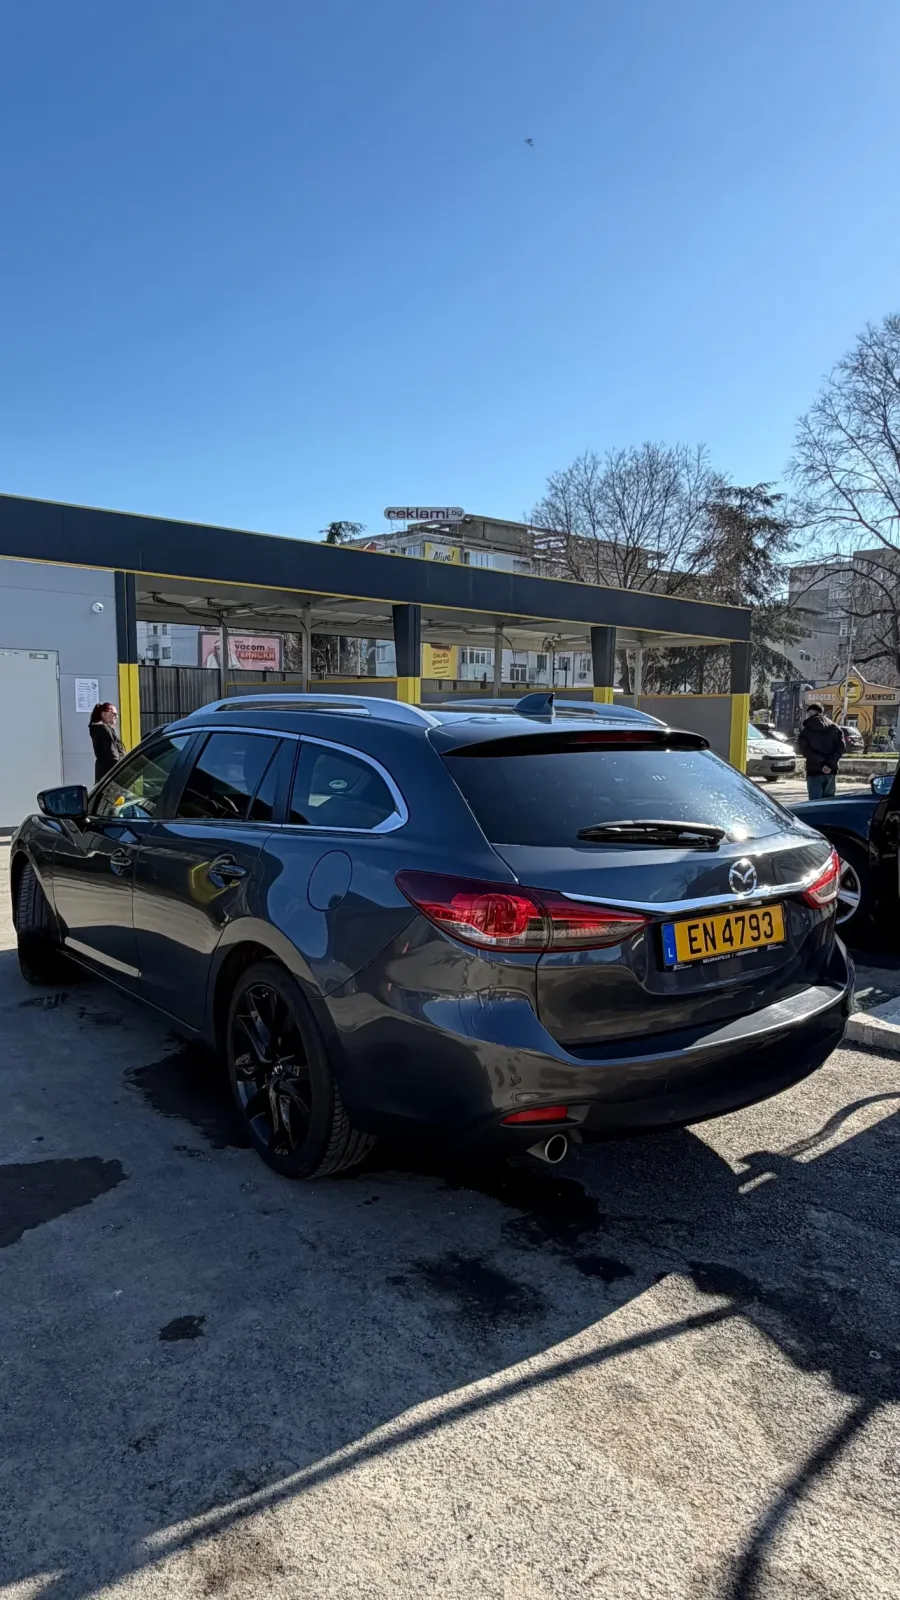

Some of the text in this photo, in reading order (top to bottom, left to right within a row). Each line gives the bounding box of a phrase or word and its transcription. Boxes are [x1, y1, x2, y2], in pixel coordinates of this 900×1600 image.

[687, 911, 774, 955] EN 4793
[667, 947, 673, 958] L
